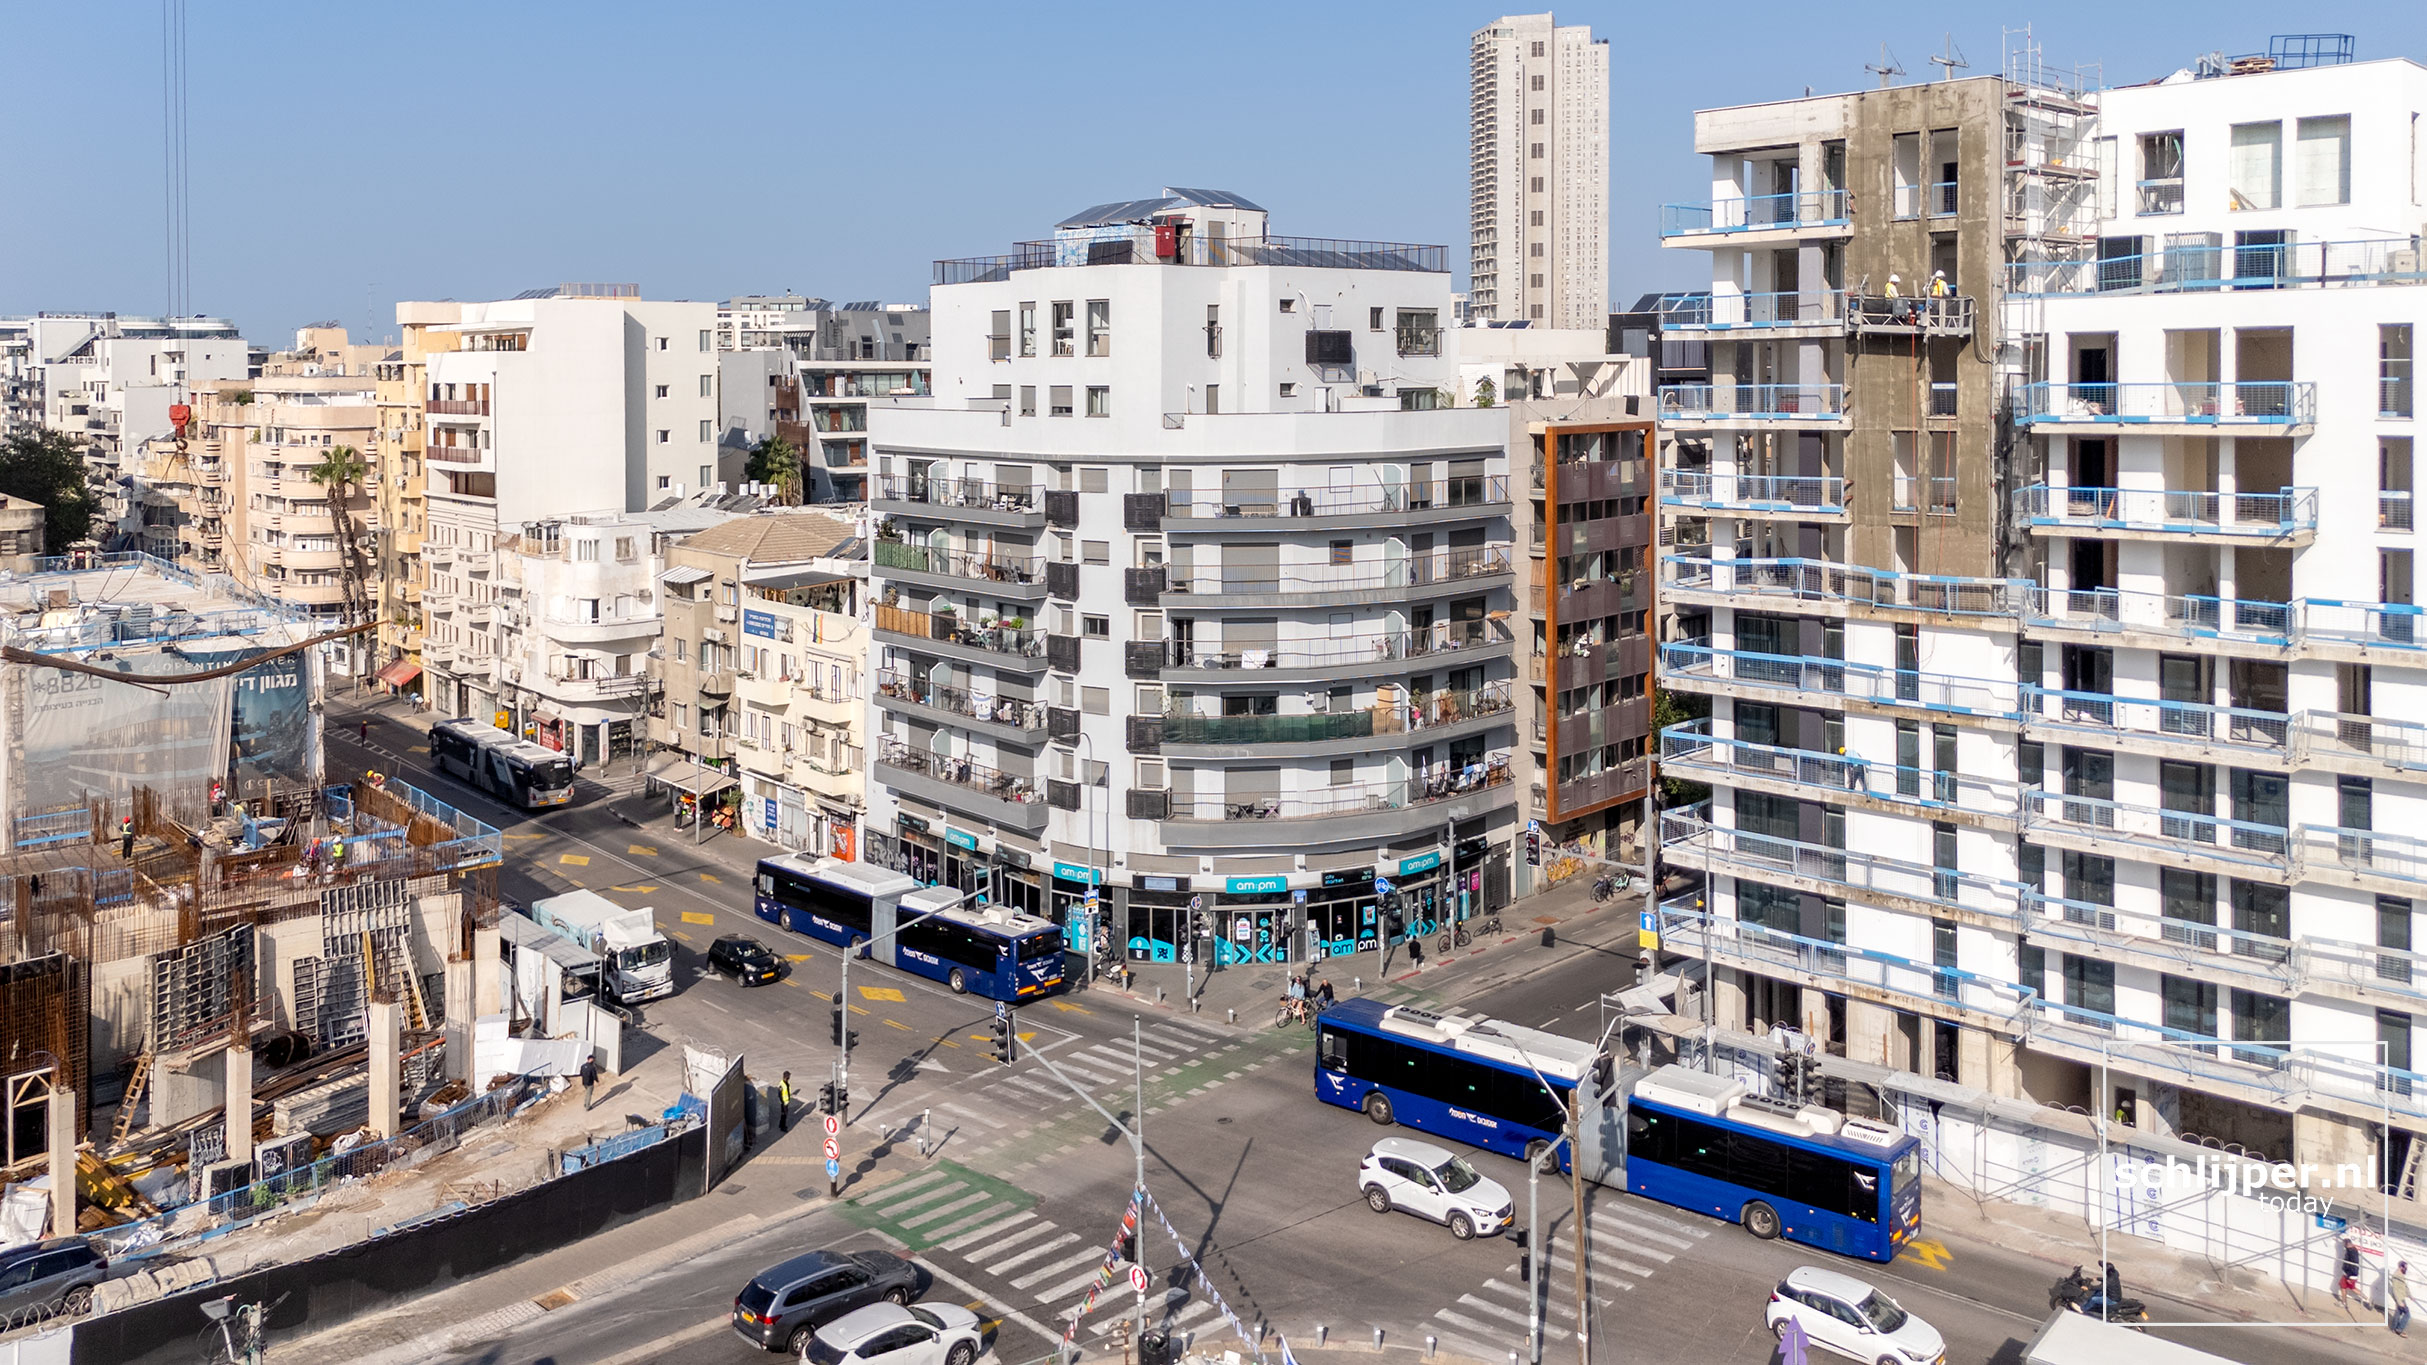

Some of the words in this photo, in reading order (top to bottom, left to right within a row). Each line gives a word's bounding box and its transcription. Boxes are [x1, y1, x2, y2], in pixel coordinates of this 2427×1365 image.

[260, 673, 298, 694] מגוון
[1332, 943, 1354, 955] am
[1357, 938, 1377, 953] pm
